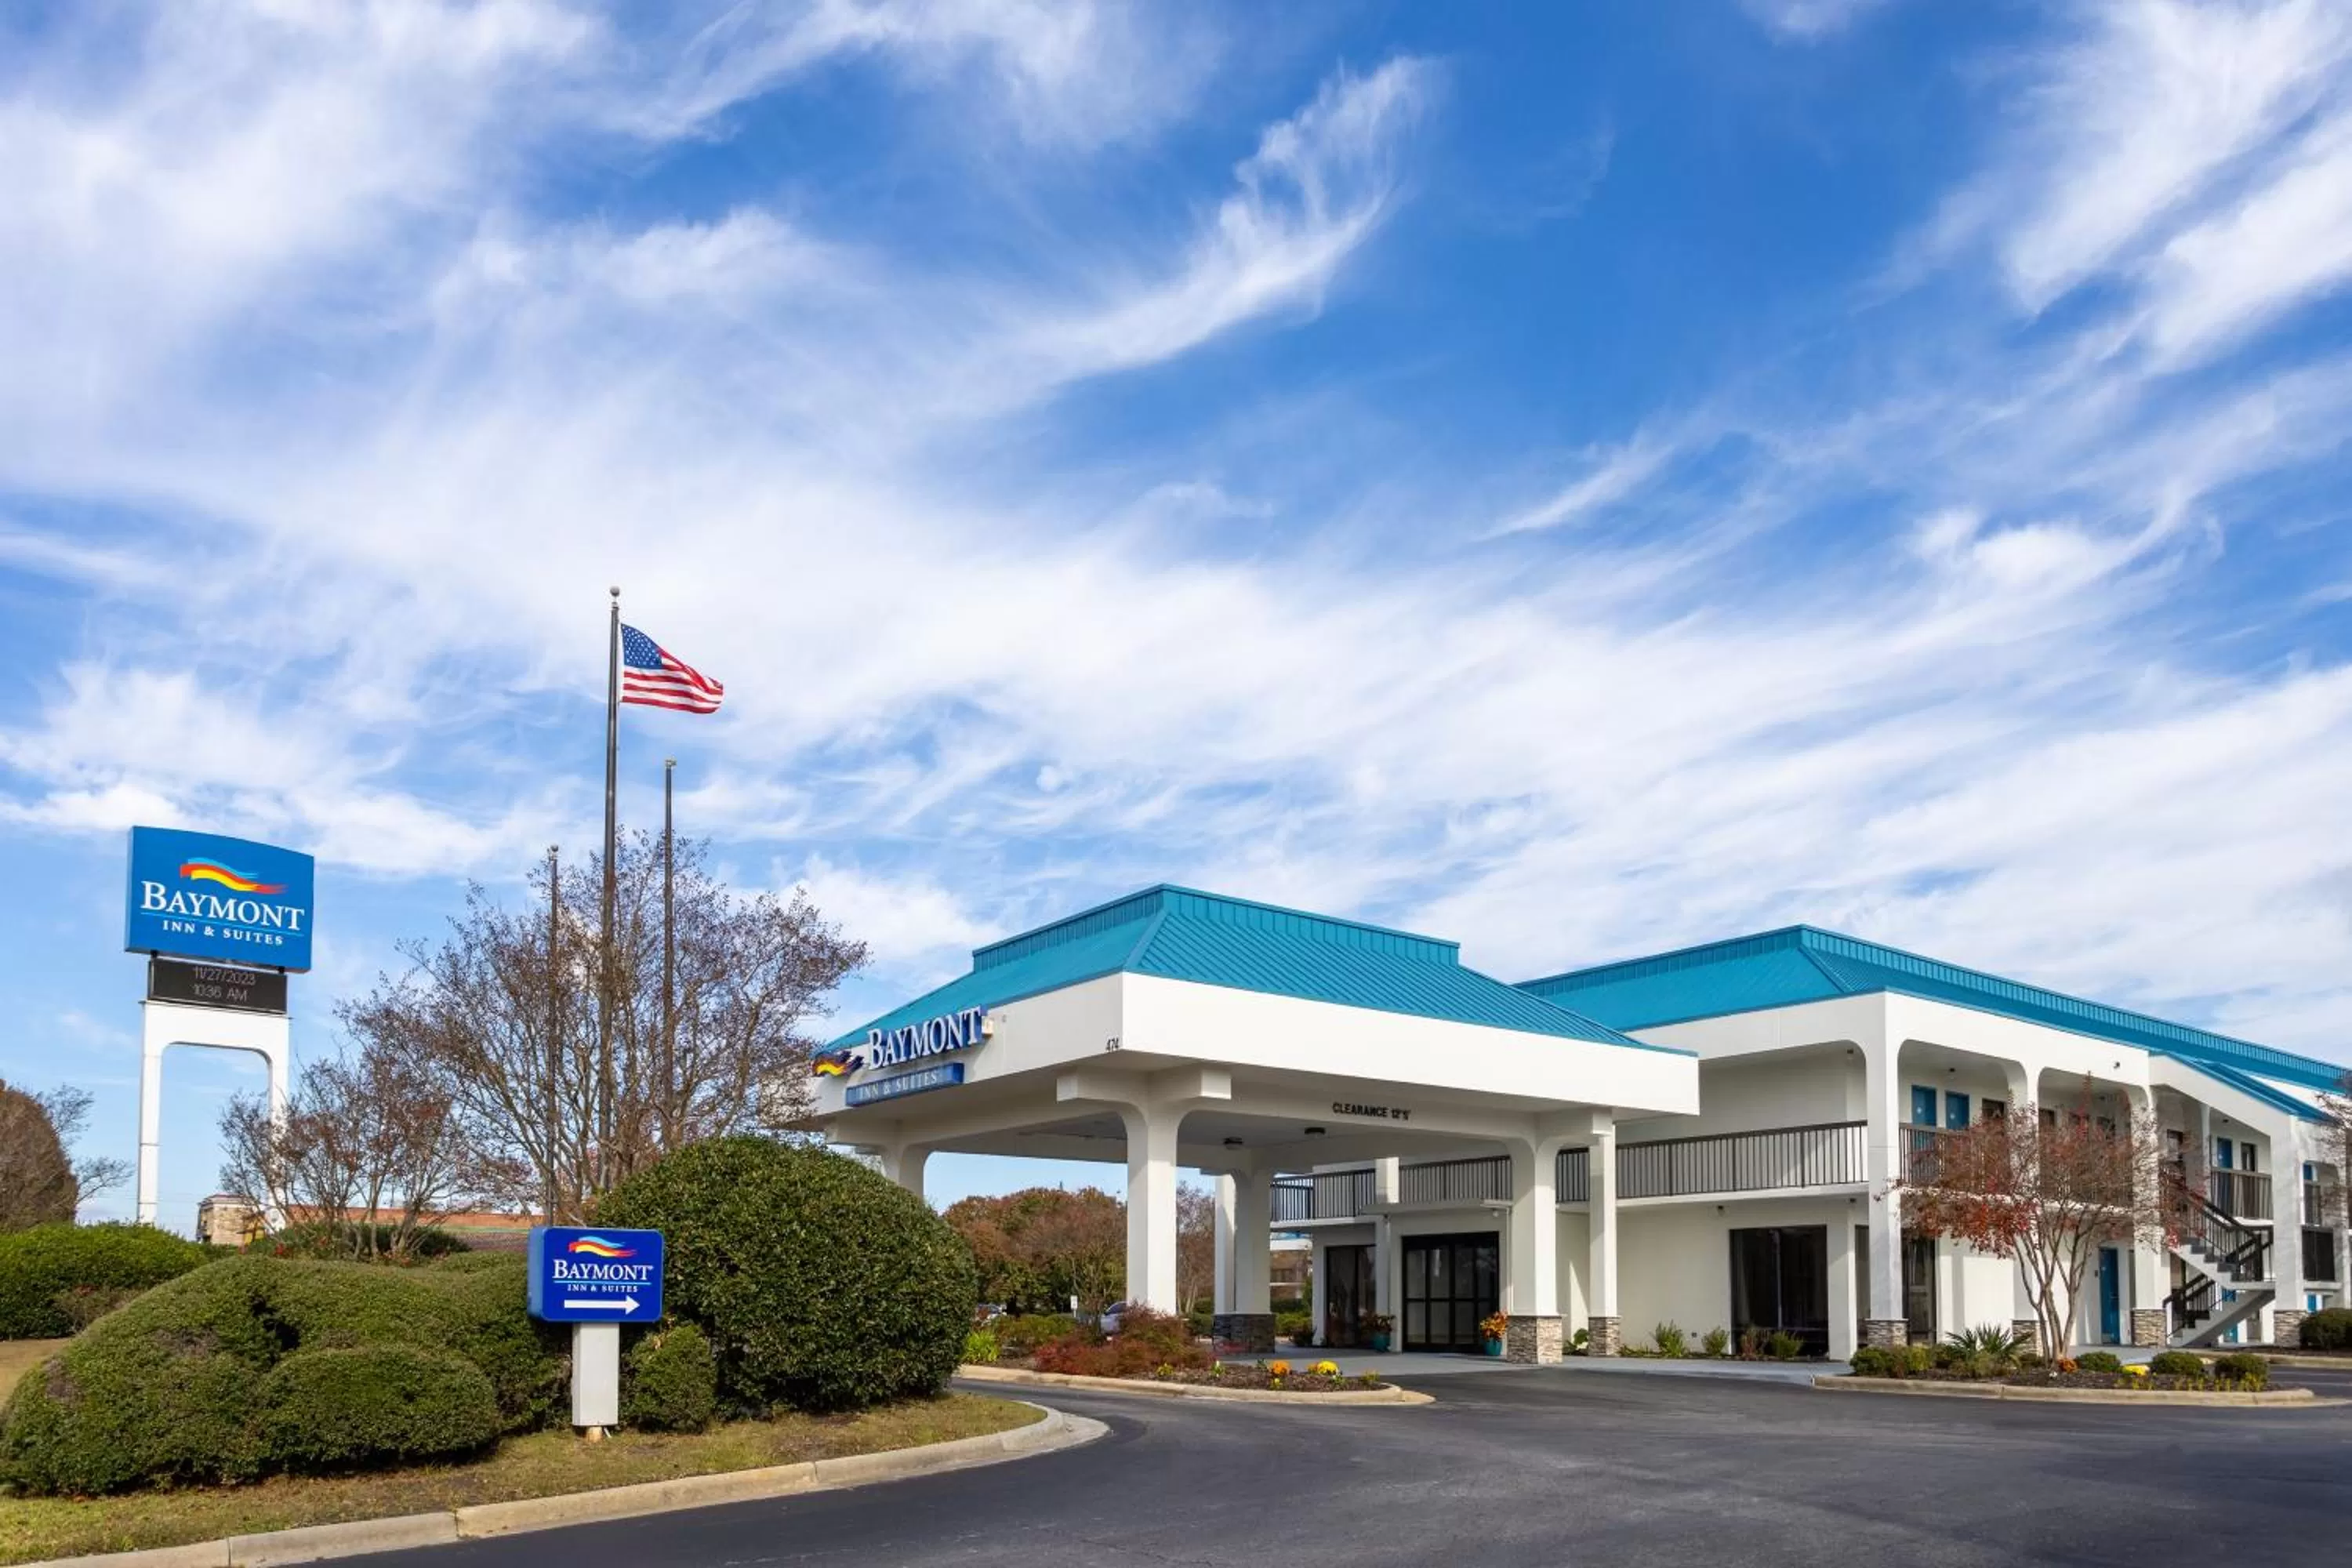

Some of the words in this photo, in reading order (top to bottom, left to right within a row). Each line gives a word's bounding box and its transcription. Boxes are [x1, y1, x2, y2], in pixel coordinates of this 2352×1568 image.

[140, 880, 304, 931] BAYMONT
[163, 920, 195, 933] INN
[204, 926, 215, 937] &
[223, 928, 283, 946] SUITES
[867, 1004, 981, 1069] BAYMONT
[859, 1083, 879, 1100] INN
[884, 1082, 891, 1095] &
[896, 1071, 938, 1092] SUITES
[1333, 1102, 1388, 1117] CLEARANCE
[553, 1259, 651, 1280] BAYMONT
